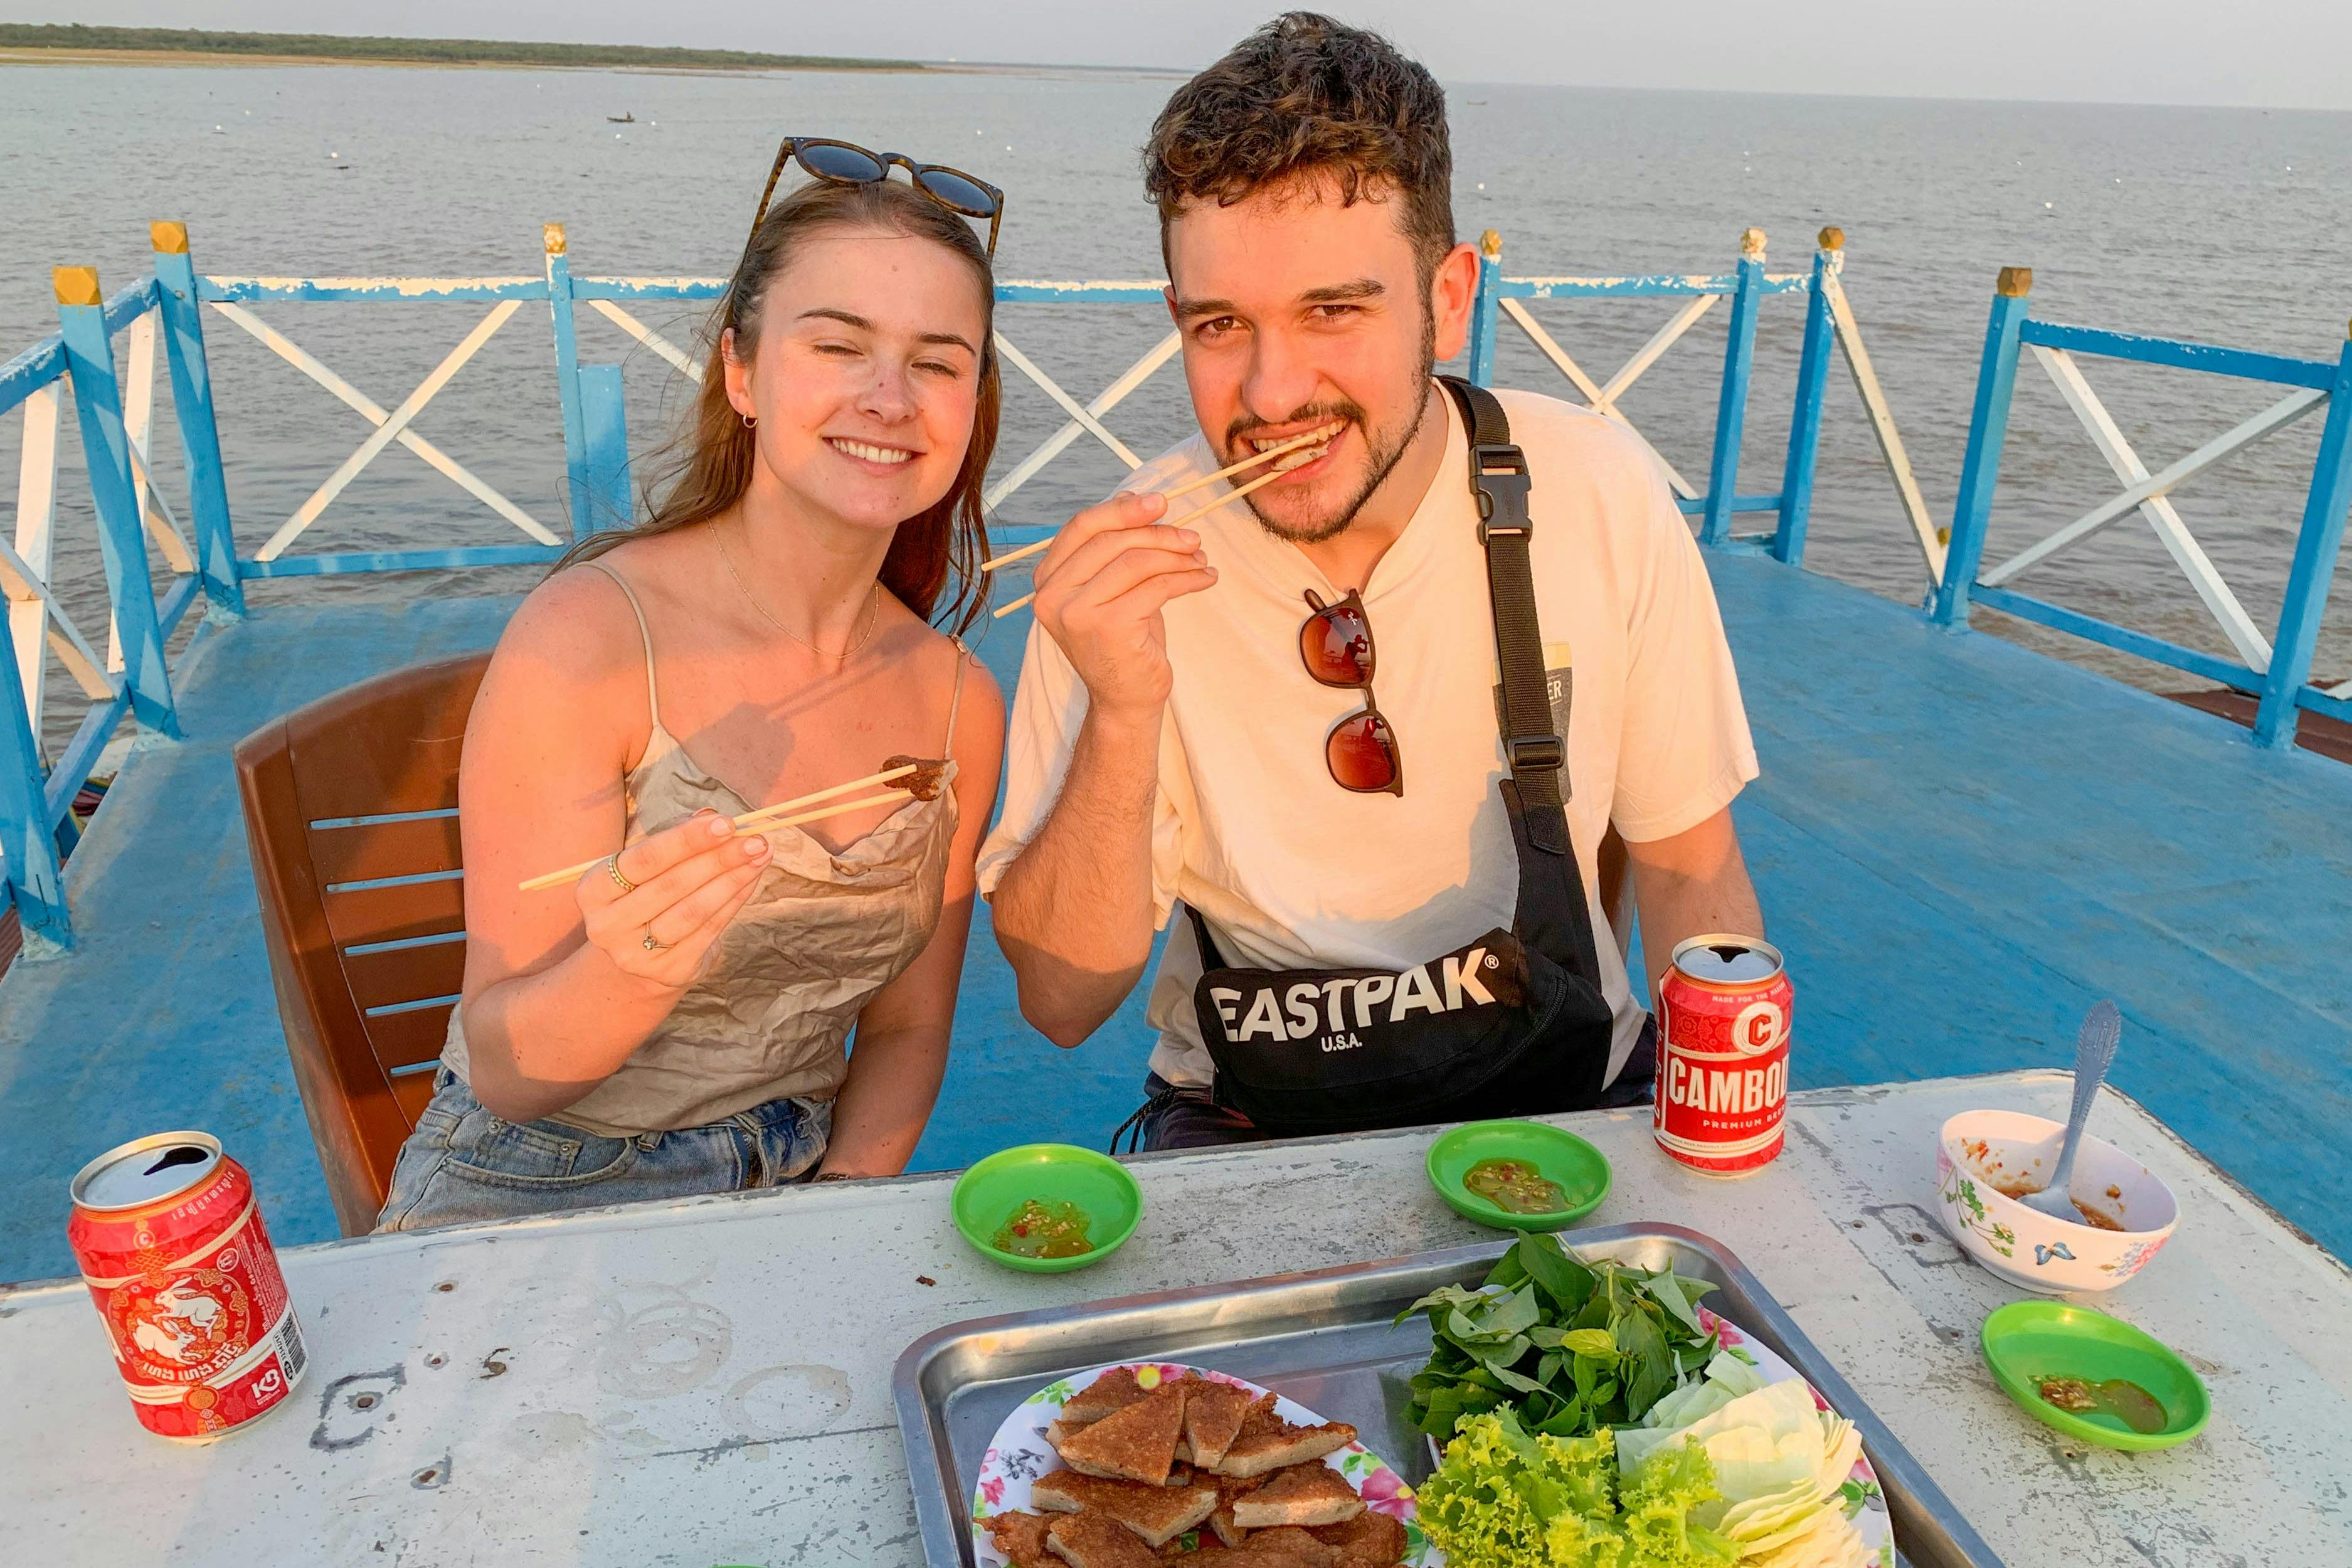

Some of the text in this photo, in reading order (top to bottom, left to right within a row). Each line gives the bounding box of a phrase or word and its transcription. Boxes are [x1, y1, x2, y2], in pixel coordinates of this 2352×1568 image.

[1749, 1014, 1772, 1047] C
[1321, 1032, 1363, 1052] U.S.A.
[1703, 1118, 1762, 1130] PREMIUM
